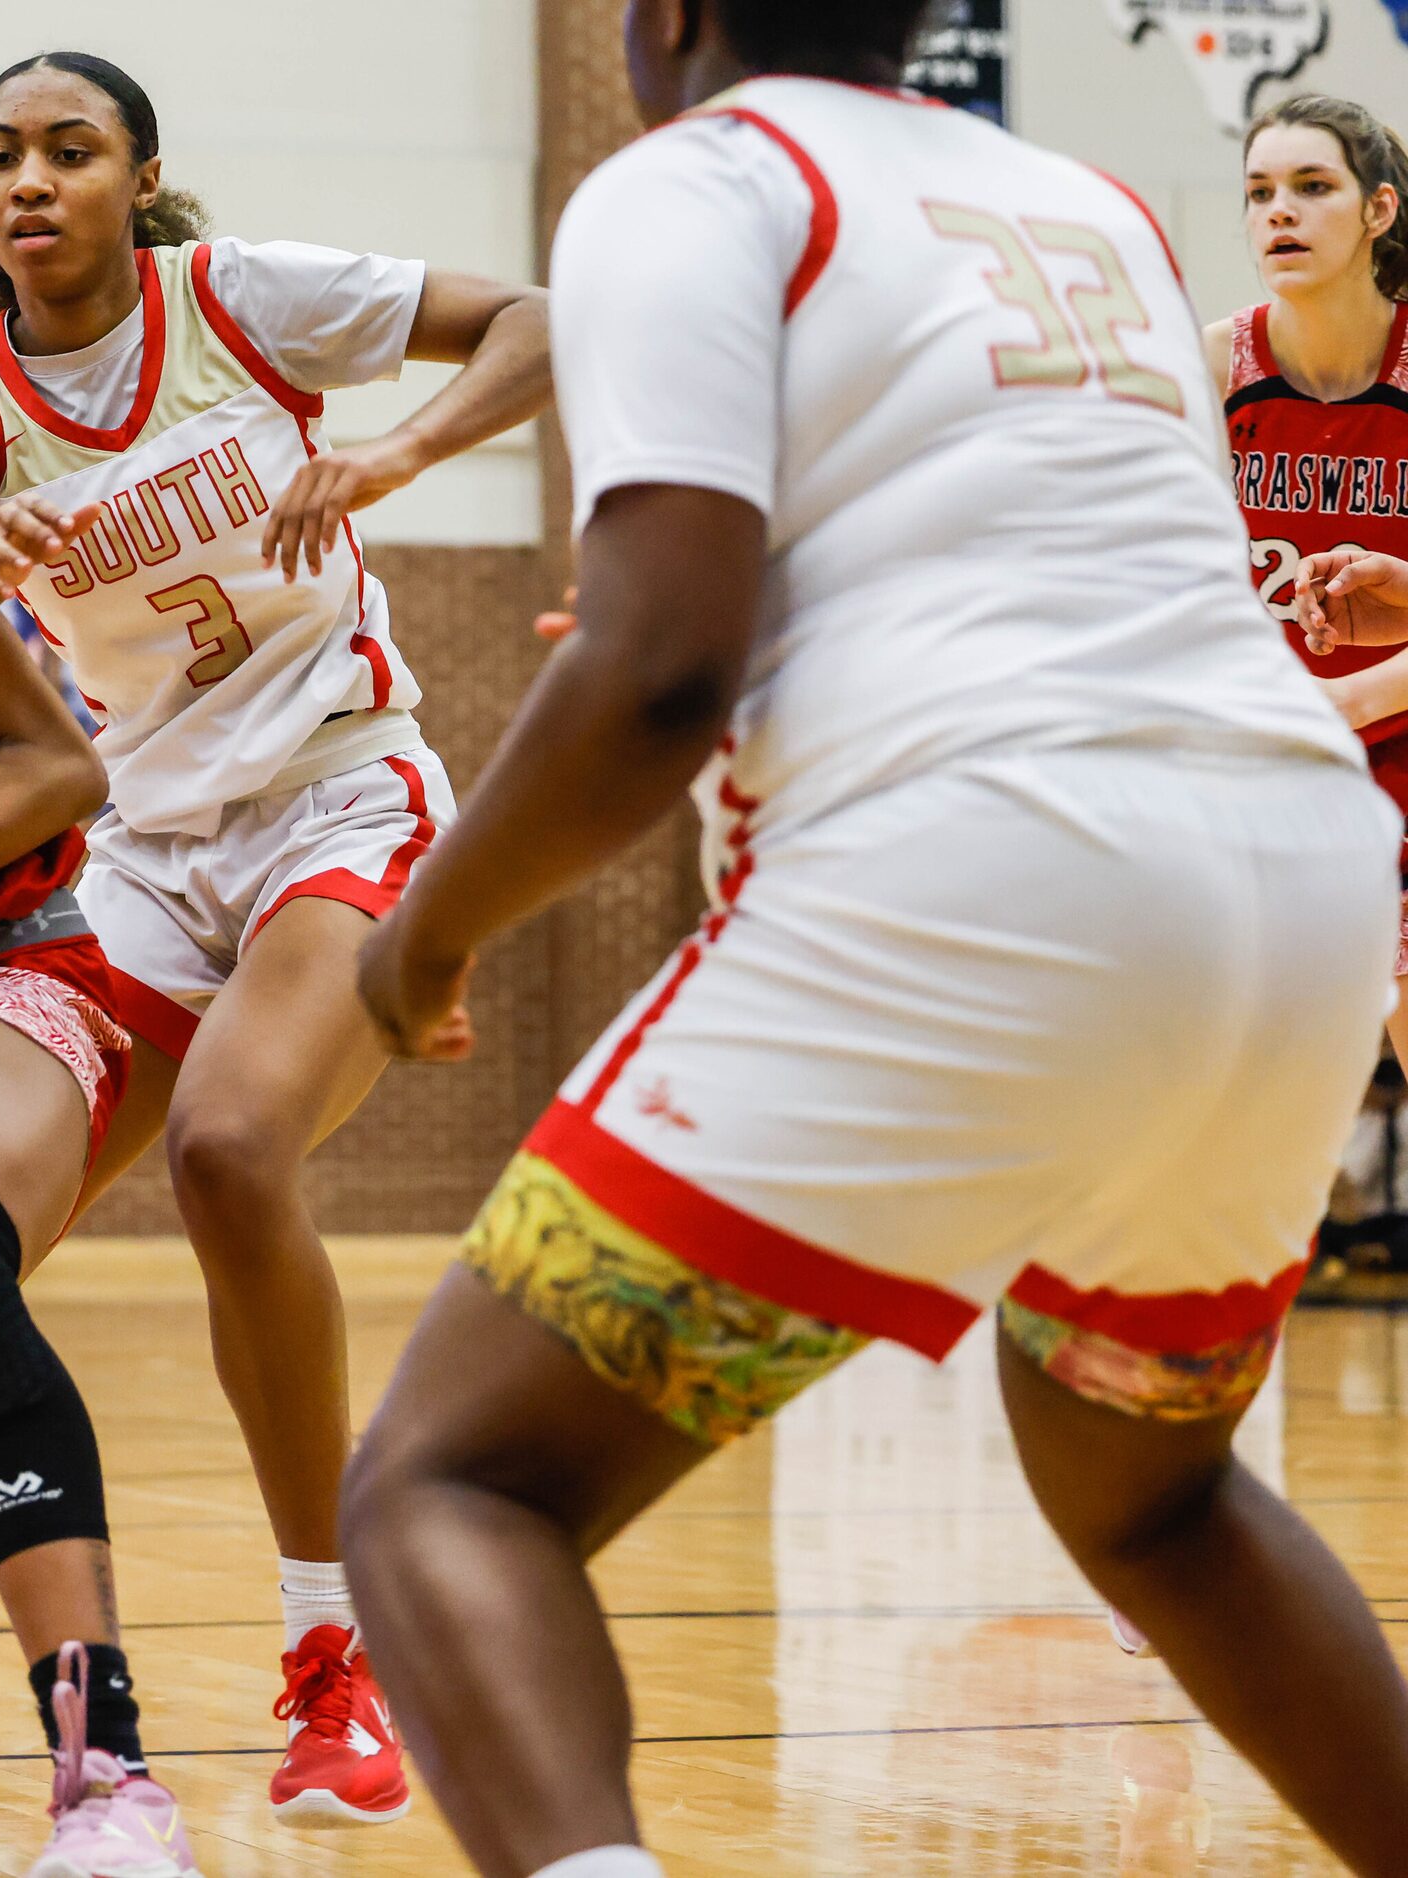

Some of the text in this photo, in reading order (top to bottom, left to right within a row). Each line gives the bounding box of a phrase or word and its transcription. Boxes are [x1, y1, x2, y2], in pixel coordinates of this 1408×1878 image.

[919, 197, 1186, 419] 32
[45, 437, 270, 599] SOUTH
[1249, 537, 1369, 623] 2
[145, 574, 254, 688] 3
